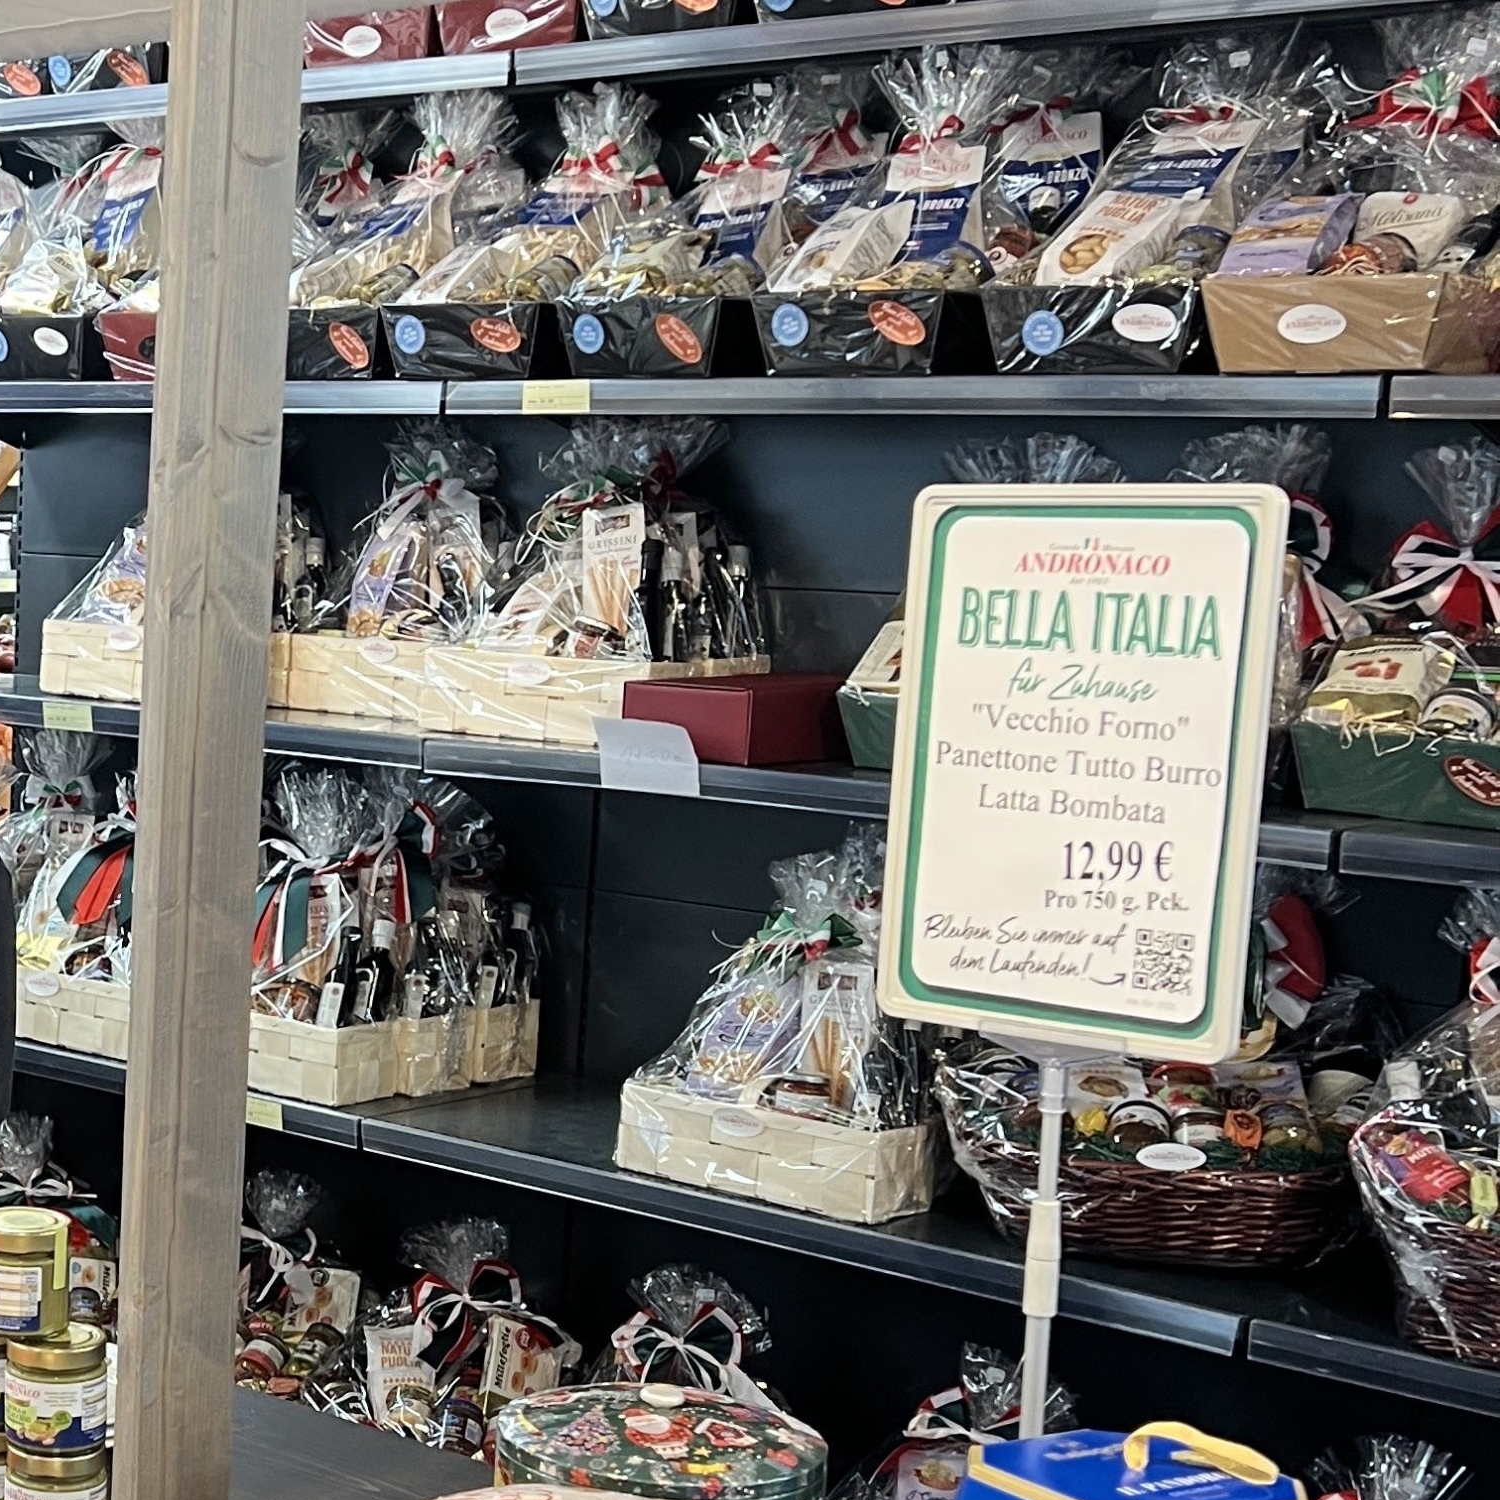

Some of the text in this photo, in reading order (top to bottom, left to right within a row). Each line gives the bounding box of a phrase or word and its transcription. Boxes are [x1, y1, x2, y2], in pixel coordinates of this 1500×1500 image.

[1046, 167, 1088, 184] BRONZO
[922, 197, 966, 211] BRONZO
[1096, 205, 1147, 225] PUGLIA
[587, 535, 638, 550] GRISSINI
[1014, 552, 1172, 576] ANDRONACO
[957, 586, 1223, 660] BELLA ITALIA
[1047, 664, 1159, 704] Zuhause
[972, 703, 1190, 743] "Vecchio Forno"
[934, 741, 1223, 789] Panettone Tutto Burro
[978, 784, 1166, 825] Latta Bombata
[1062, 840, 1175, 888] 12,99 €
[1044, 889, 1078, 910] Pro
[1083, 889, 1115, 911] 750
[923, 913, 1128, 954] Bleiben Sie immer auf
[949, 945, 1094, 980] dem Laufenden!
[381, 1340, 412, 1356] NATU
